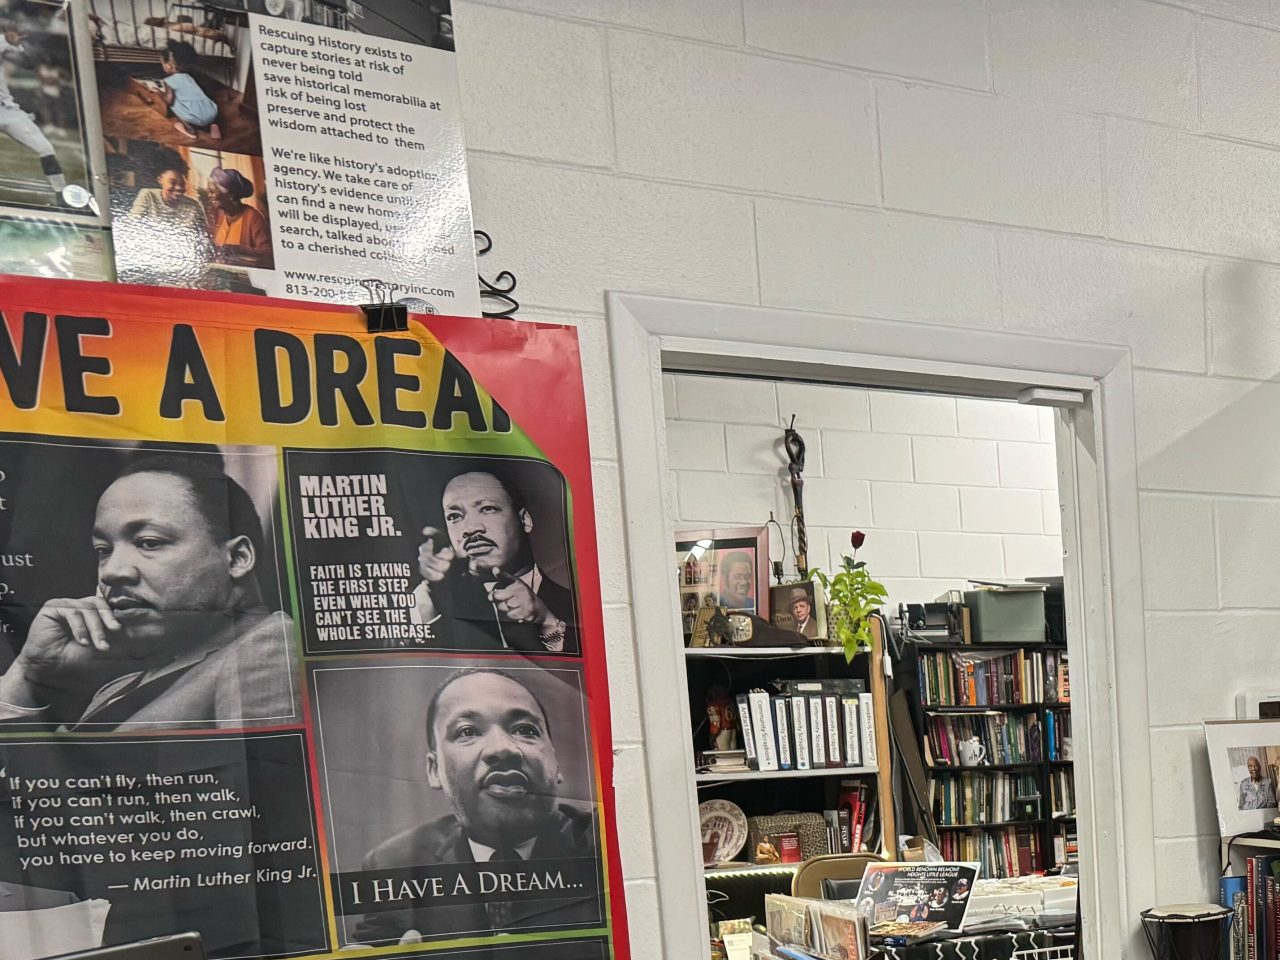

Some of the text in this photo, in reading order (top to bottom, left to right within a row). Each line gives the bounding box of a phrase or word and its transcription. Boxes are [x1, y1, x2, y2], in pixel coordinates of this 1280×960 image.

[259, 25, 412, 62] Rescuing History exists to
[260, 42, 405, 75] capture stories at risk of
[159, 323, 226, 423] A
[299, 474, 387, 496] MARTIN
[301, 496, 384, 518] LUTHER
[303, 516, 401, 539] KING JR.
[310, 564, 411, 579] FAITH IS TAKING
[311, 579, 409, 595] THE FIRST STEP
[313, 594, 415, 610] EVEN WHEN YOU
[315, 609, 407, 626] CAN'T SEE THE
[317, 624, 435, 642] WHOLE STAIRCASE.
[10, 773, 219, 792] If you can't fly, then run,
[133, 866, 317, 892] Martin Luther King Jr.
[351, 881, 359, 905] I
[373, 877, 444, 904] HAVE
[452, 873, 472, 896] A
